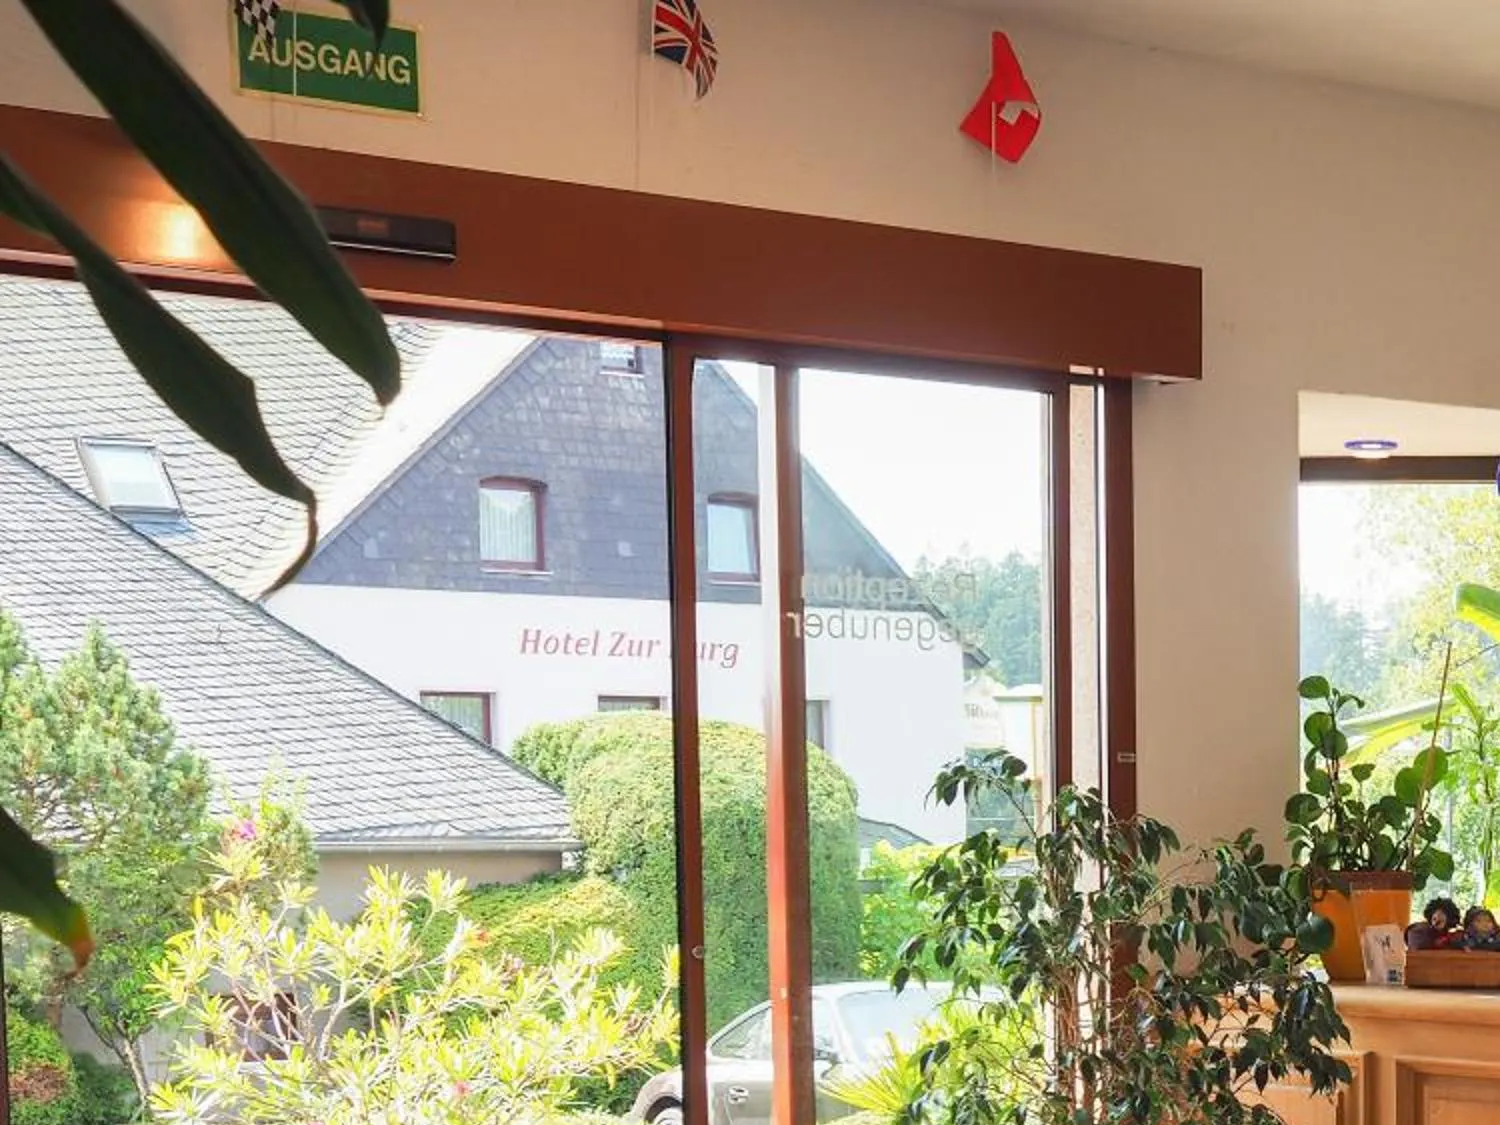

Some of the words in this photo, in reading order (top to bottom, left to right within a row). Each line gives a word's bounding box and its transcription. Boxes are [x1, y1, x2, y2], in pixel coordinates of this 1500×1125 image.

[248, 36, 411, 84] AUSGANG
[520, 627, 601, 657] Hotel
[608, 631, 661, 658] Zur
[668, 636, 740, 669] urg
